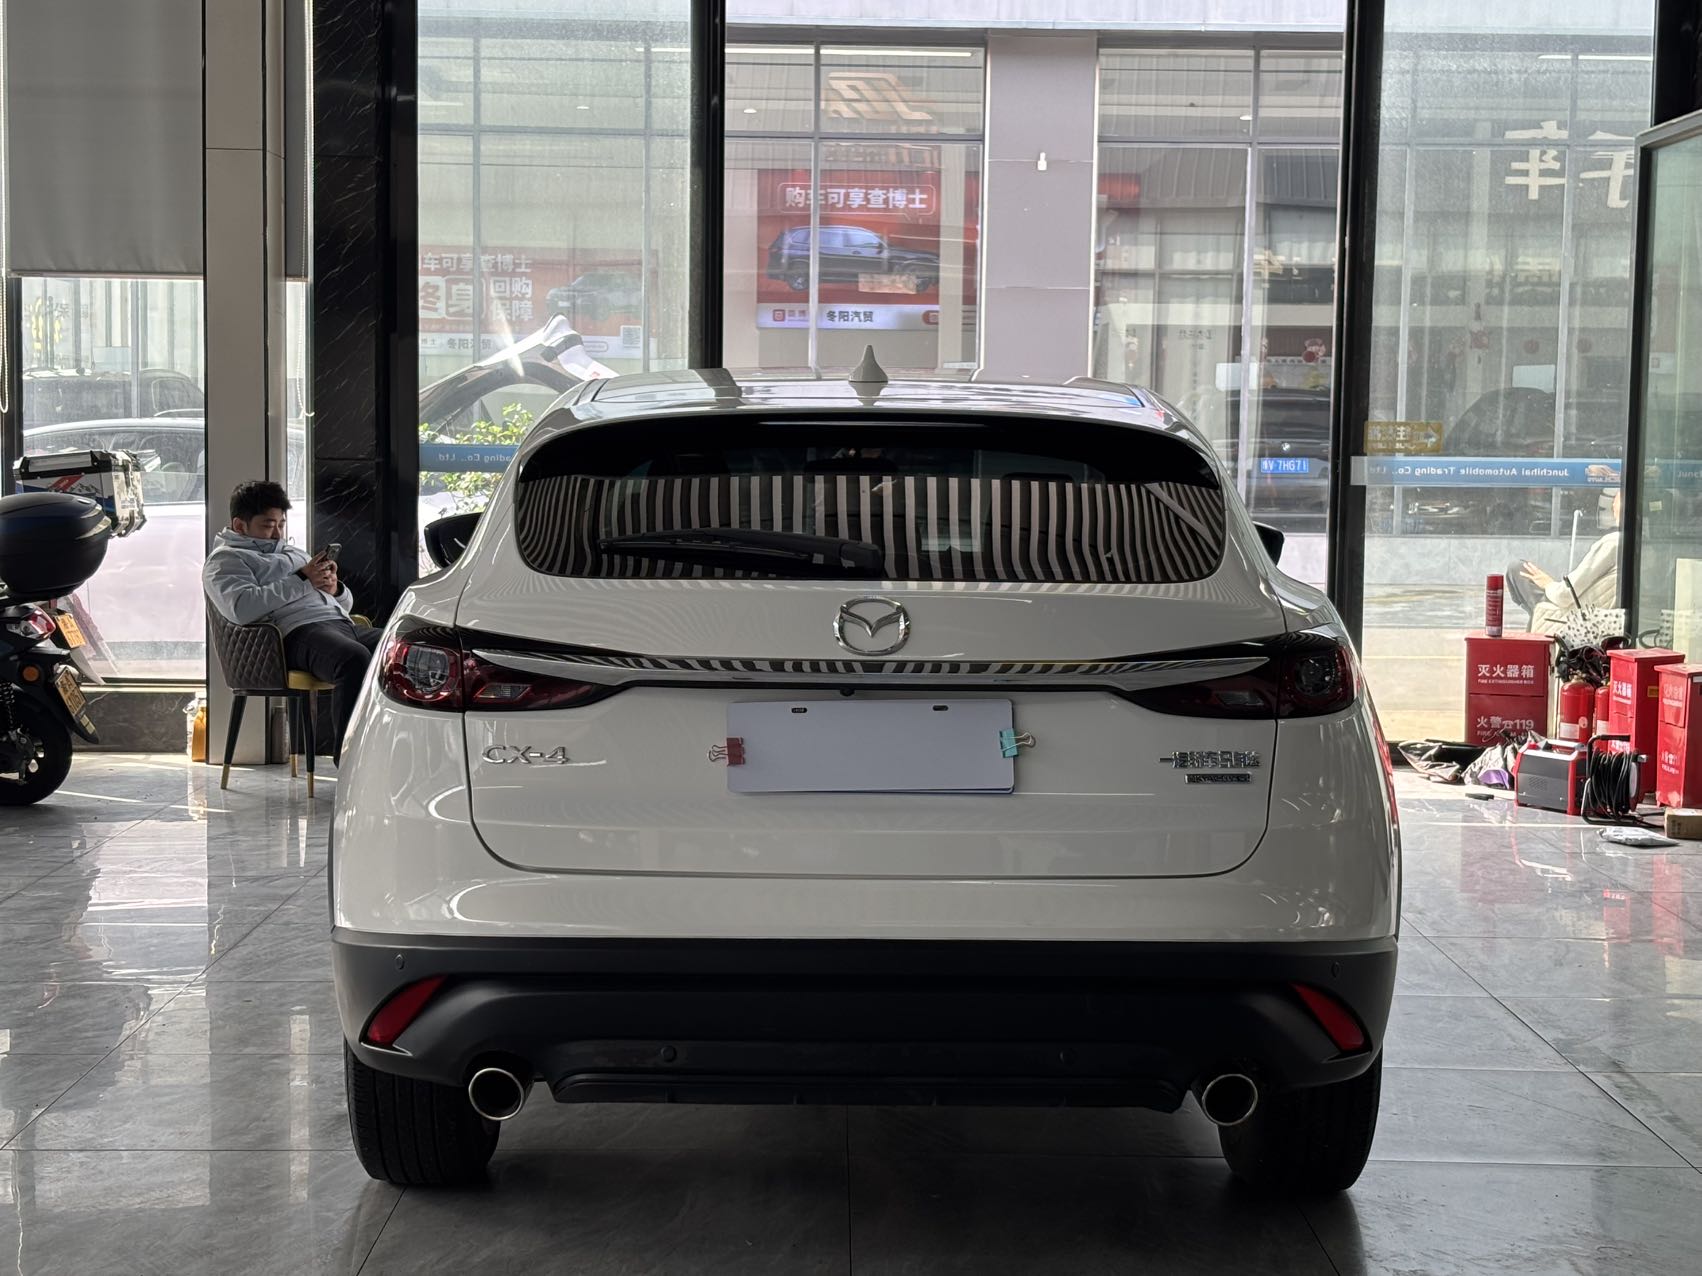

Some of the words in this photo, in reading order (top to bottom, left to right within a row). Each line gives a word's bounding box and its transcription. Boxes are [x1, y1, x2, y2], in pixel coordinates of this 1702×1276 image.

[785, 187, 928, 209] 购车可享查博士
[419, 252, 531, 272] 车可享查博士
[490, 276, 532, 297] 回购
[826, 310, 874, 323] 冬阳汽贸
[1477, 664, 1535, 678] 灭火器箱
[482, 744, 569, 764] CX-4
